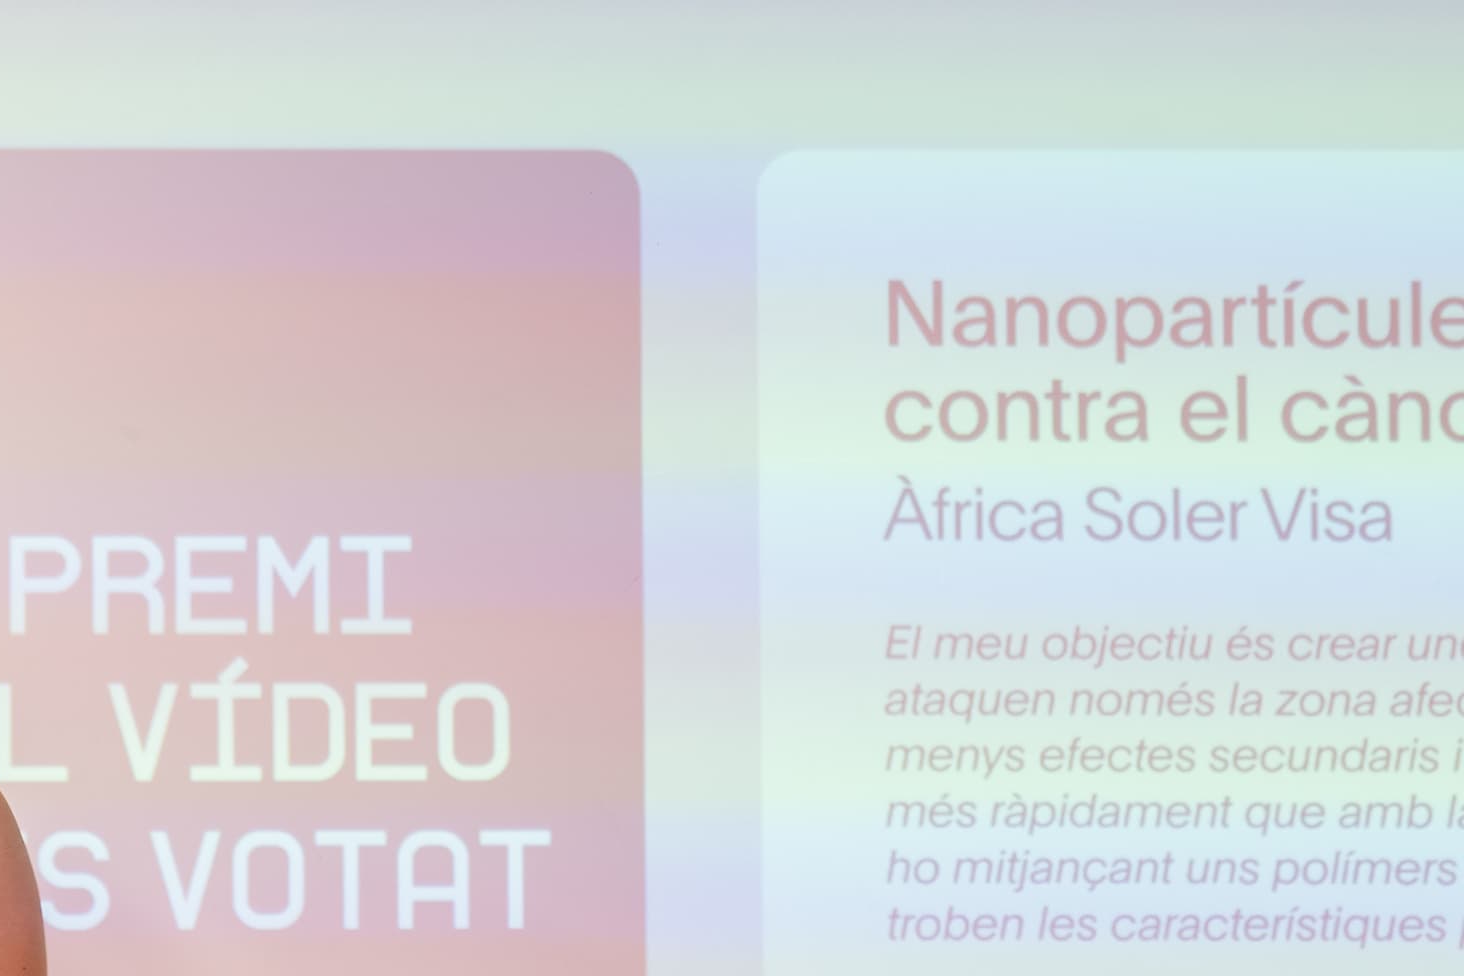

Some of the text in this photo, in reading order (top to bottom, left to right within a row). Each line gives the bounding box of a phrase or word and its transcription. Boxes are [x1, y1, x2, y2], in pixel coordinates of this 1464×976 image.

[885, 379, 1149, 443] contra
[1180, 374, 1248, 443] el
[884, 475, 1393, 543] Àfrica Soler Visa
[9, 536, 412, 634] PREMI
[886, 626, 1464, 669] El meu objectiu és crear un
[108, 657, 510, 782] VÍDEO
[885, 683, 1055, 724] ataquen
[1070, 683, 1215, 717] només
[1230, 682, 1262, 717] la
[1276, 689, 1377, 717] zona
[886, 745, 1025, 779] menys
[1040, 738, 1196, 773] efectes
[1210, 738, 1439, 773] secundaris
[887, 795, 977, 829] més
[991, 794, 1232, 836] ràpidament
[1246, 802, 1325, 836] que
[1339, 794, 1433, 829] amb
[150, 829, 551, 930] VOTAT
[888, 850, 1458, 893] ho mitjançant uns polímers
[890, 907, 1025, 942] troben
[1039, 907, 1098, 942] les
[1112, 906, 1447, 949] característiques
